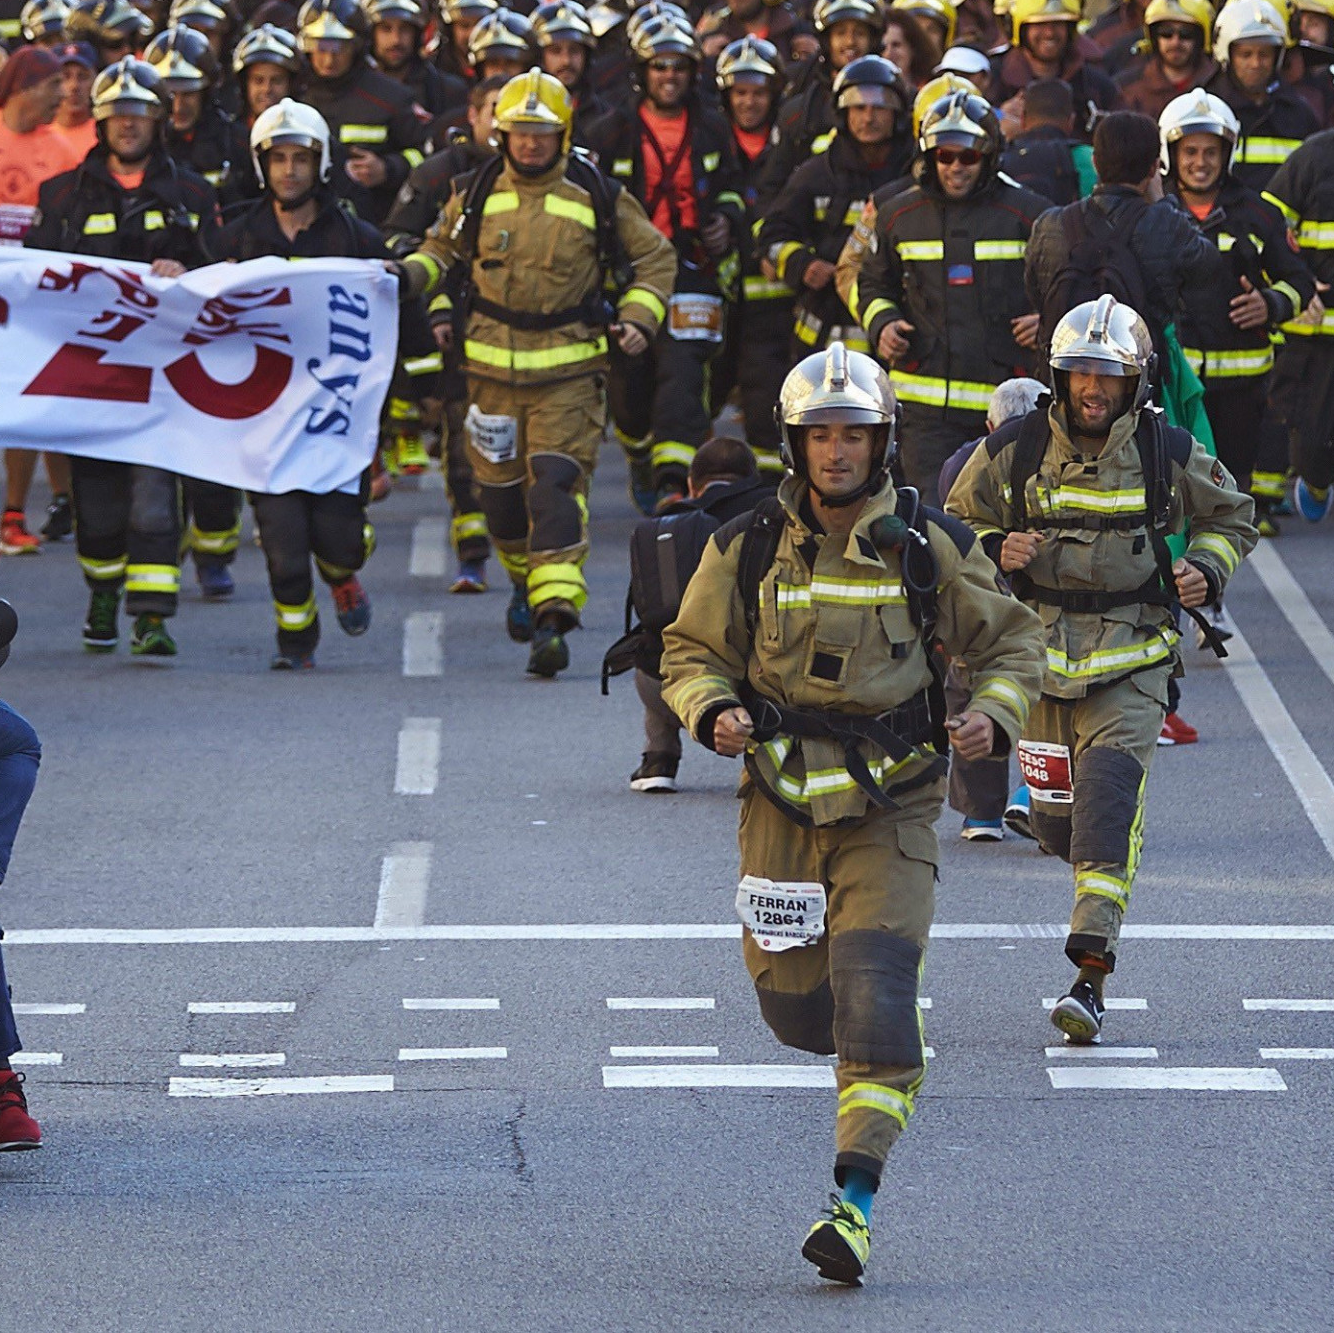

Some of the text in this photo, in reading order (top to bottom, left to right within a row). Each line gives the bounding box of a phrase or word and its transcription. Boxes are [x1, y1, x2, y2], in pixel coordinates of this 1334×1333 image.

[306, 284, 373, 437] anys
[1018, 750, 1047, 768] CESC
[1020, 762, 1050, 782] 1048
[749, 894, 807, 912] FERRAN
[754, 910, 805, 926] 12864
